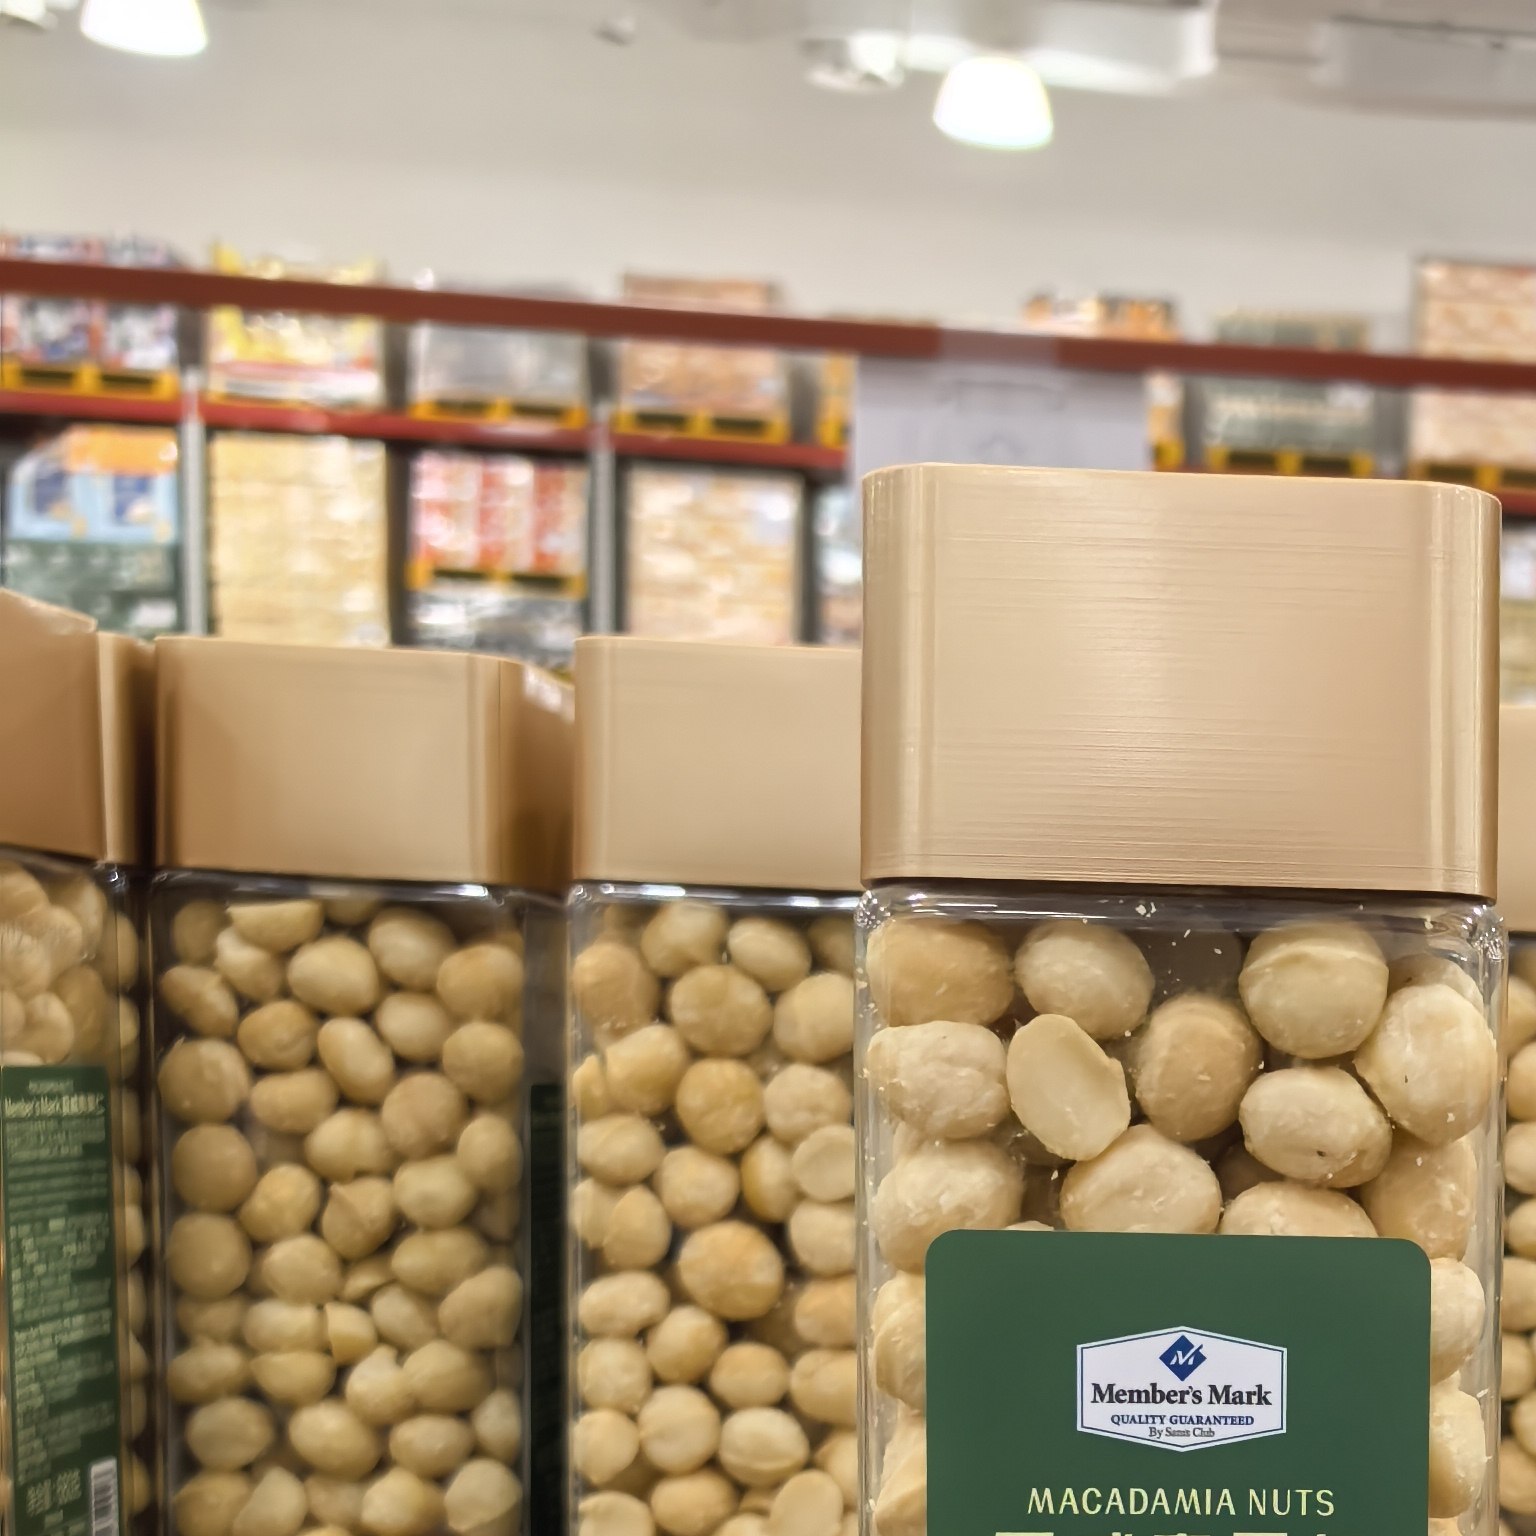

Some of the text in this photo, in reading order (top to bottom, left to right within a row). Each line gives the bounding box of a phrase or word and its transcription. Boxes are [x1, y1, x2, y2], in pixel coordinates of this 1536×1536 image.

[1091, 1383, 1273, 1406] Member's Mark
[1111, 1414, 1254, 1426] QUALITY GUARANTEED
[1149, 1427, 1163, 1439] By
[1192, 1427, 1215, 1438] Club
[1026, 1487, 1336, 1517] MACADAMIA NUTS
